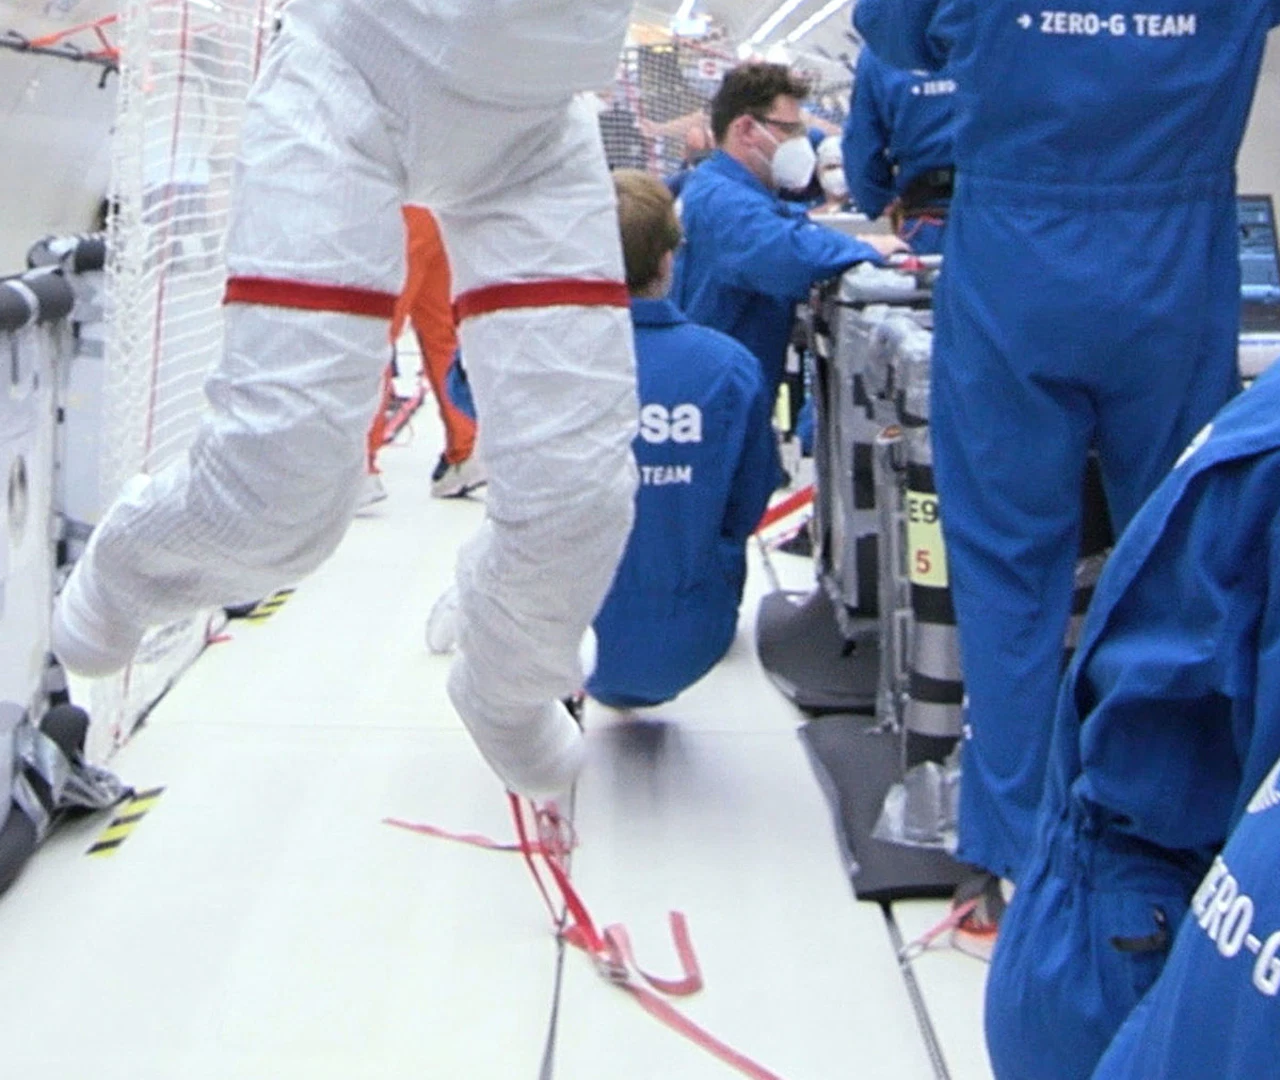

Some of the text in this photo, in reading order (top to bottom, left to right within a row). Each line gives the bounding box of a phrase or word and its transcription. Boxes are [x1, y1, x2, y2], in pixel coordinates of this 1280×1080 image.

[1040, 10, 1197, 38] ZERO-G TEAM
[923, 80, 957, 96] ZERO
[638, 403, 703, 444] sa
[641, 465, 693, 486] TEAM
[908, 499, 939, 525] E9
[915, 548, 931, 575] 5
